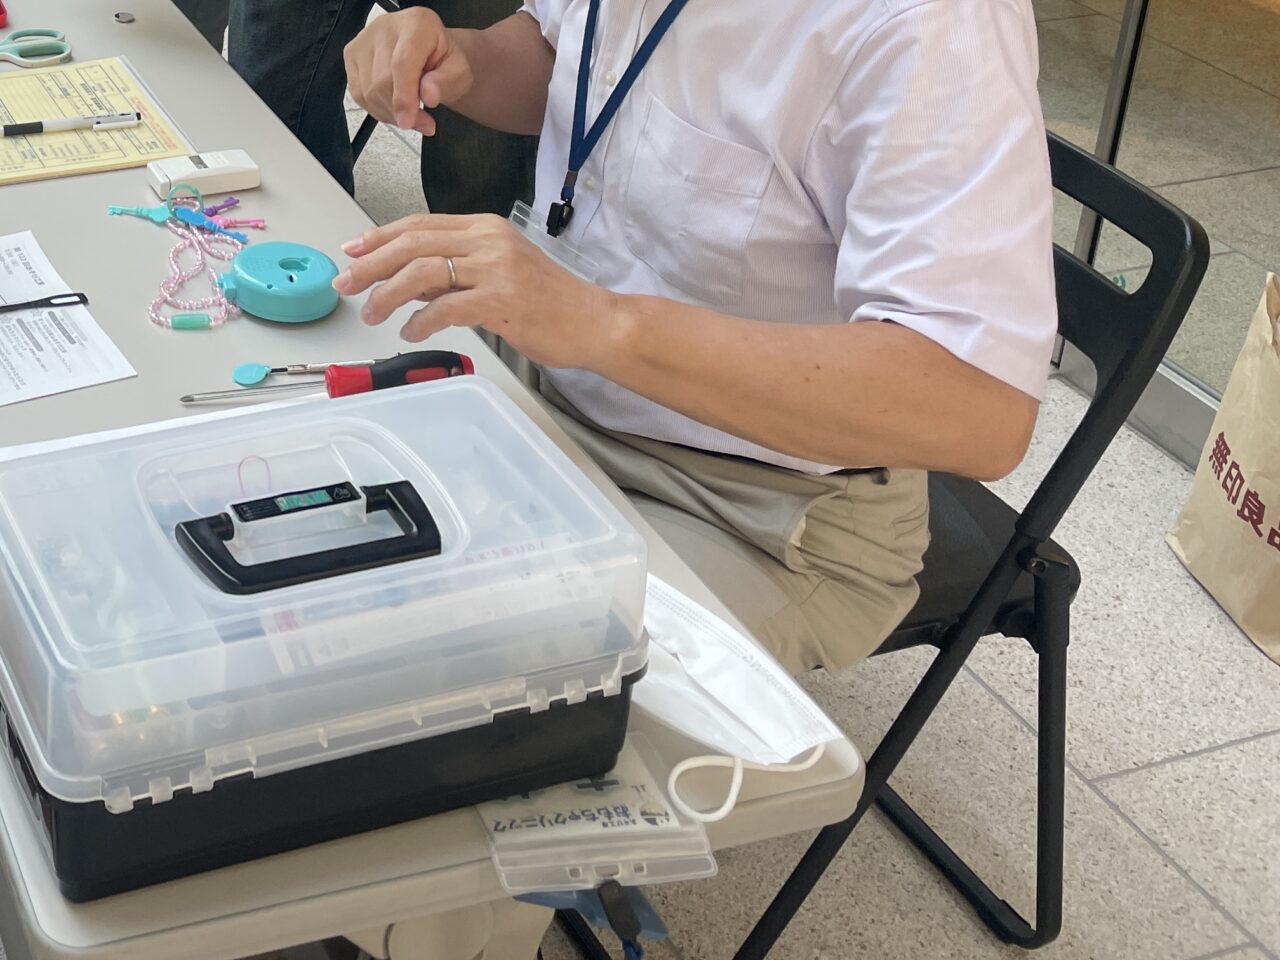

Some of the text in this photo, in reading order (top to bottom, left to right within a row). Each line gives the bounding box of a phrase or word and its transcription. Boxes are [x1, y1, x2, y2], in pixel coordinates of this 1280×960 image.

[494, 806, 630, 831] おもちゃクリニック
